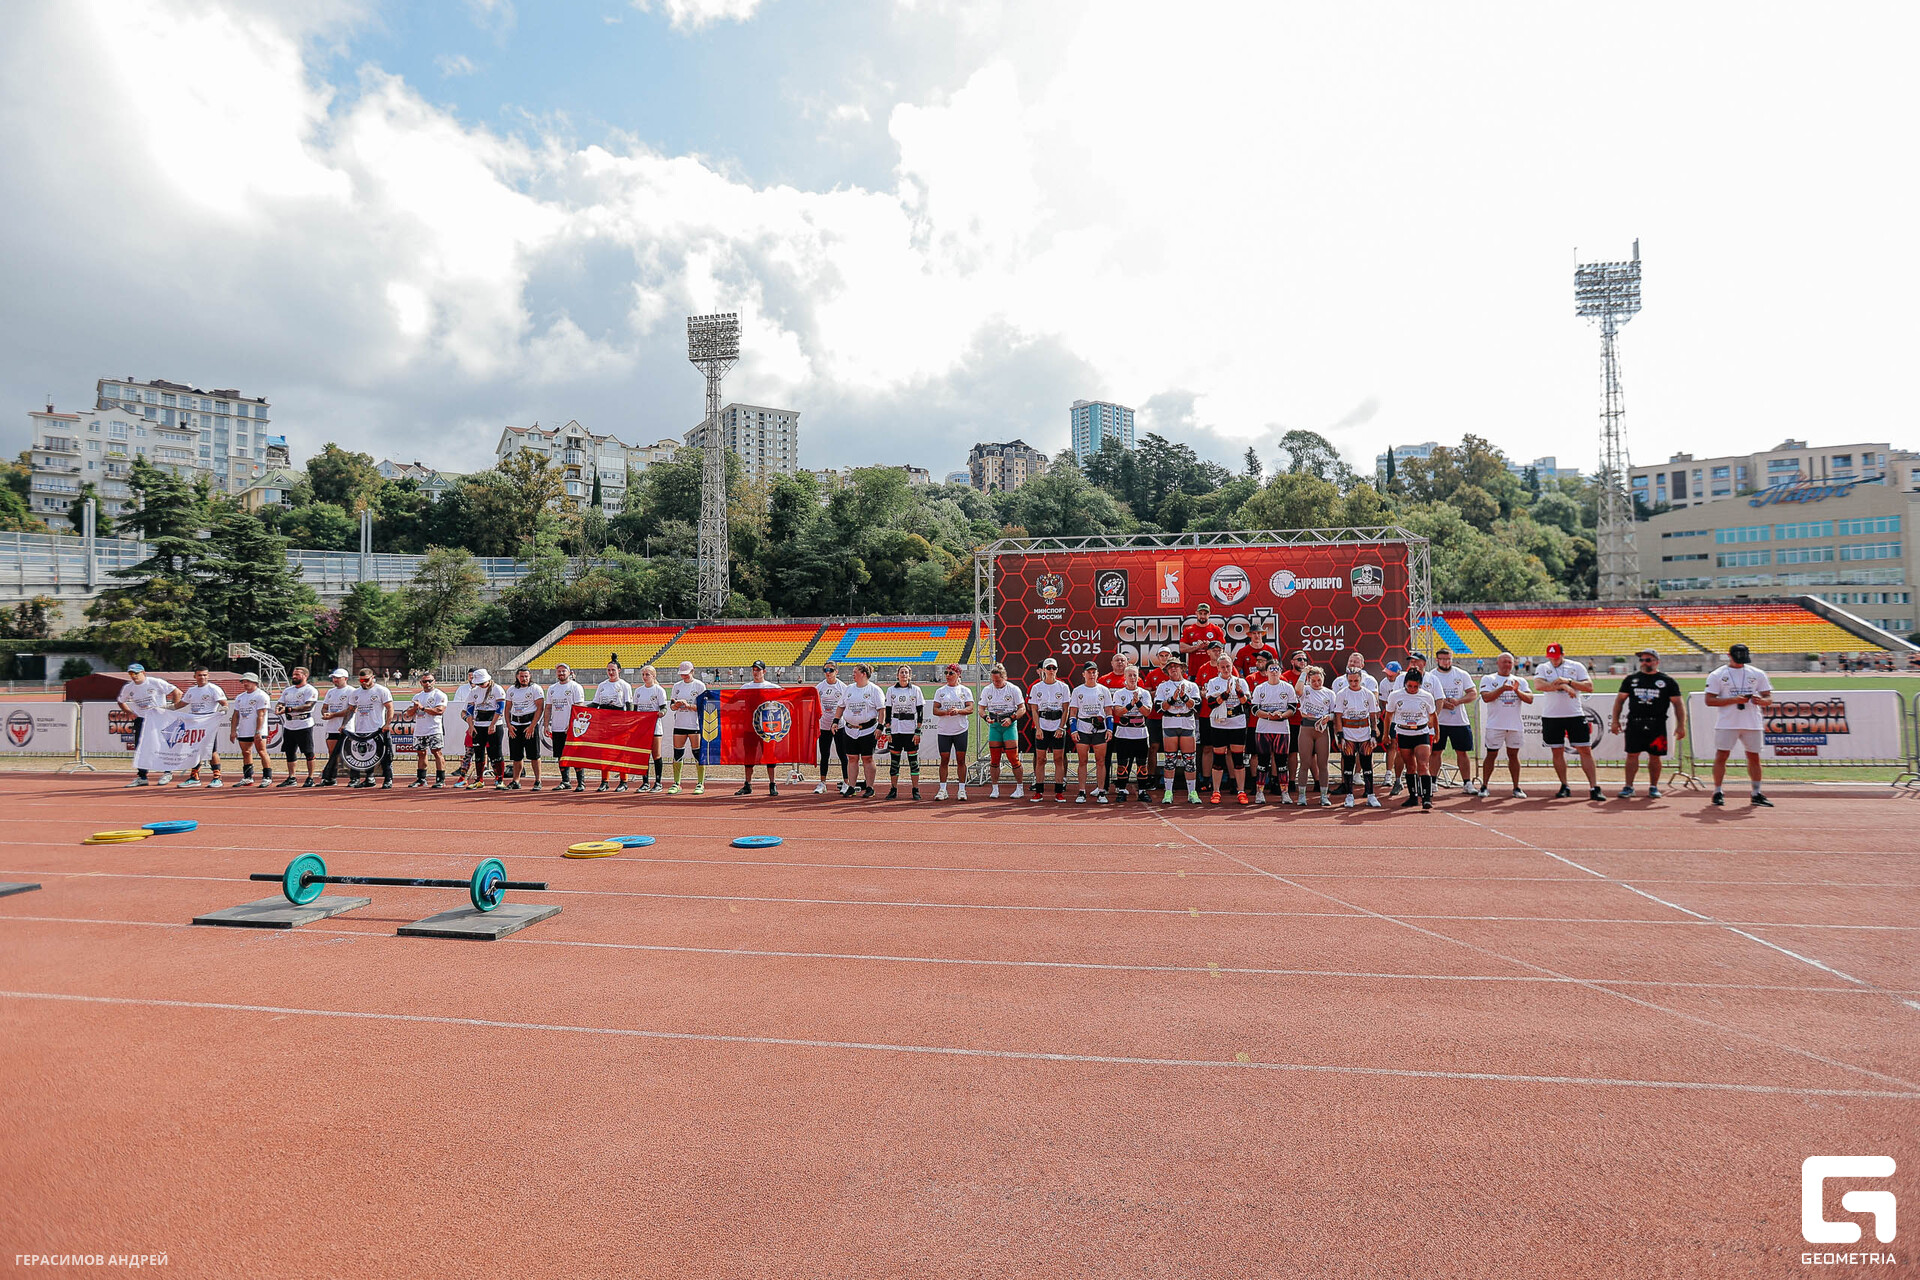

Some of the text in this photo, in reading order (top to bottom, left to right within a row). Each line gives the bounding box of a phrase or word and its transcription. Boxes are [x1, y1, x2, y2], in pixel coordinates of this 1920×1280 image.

[1295, 577, 1342, 589] БУРЭНЕРГО
[1100, 597, 1125, 607] ЦСП
[1060, 629, 1101, 641] СОЧИ
[1300, 625, 1344, 637] СОЧИ
[1061, 643, 1101, 655] 2025
[1301, 639, 1345, 651] 2025
